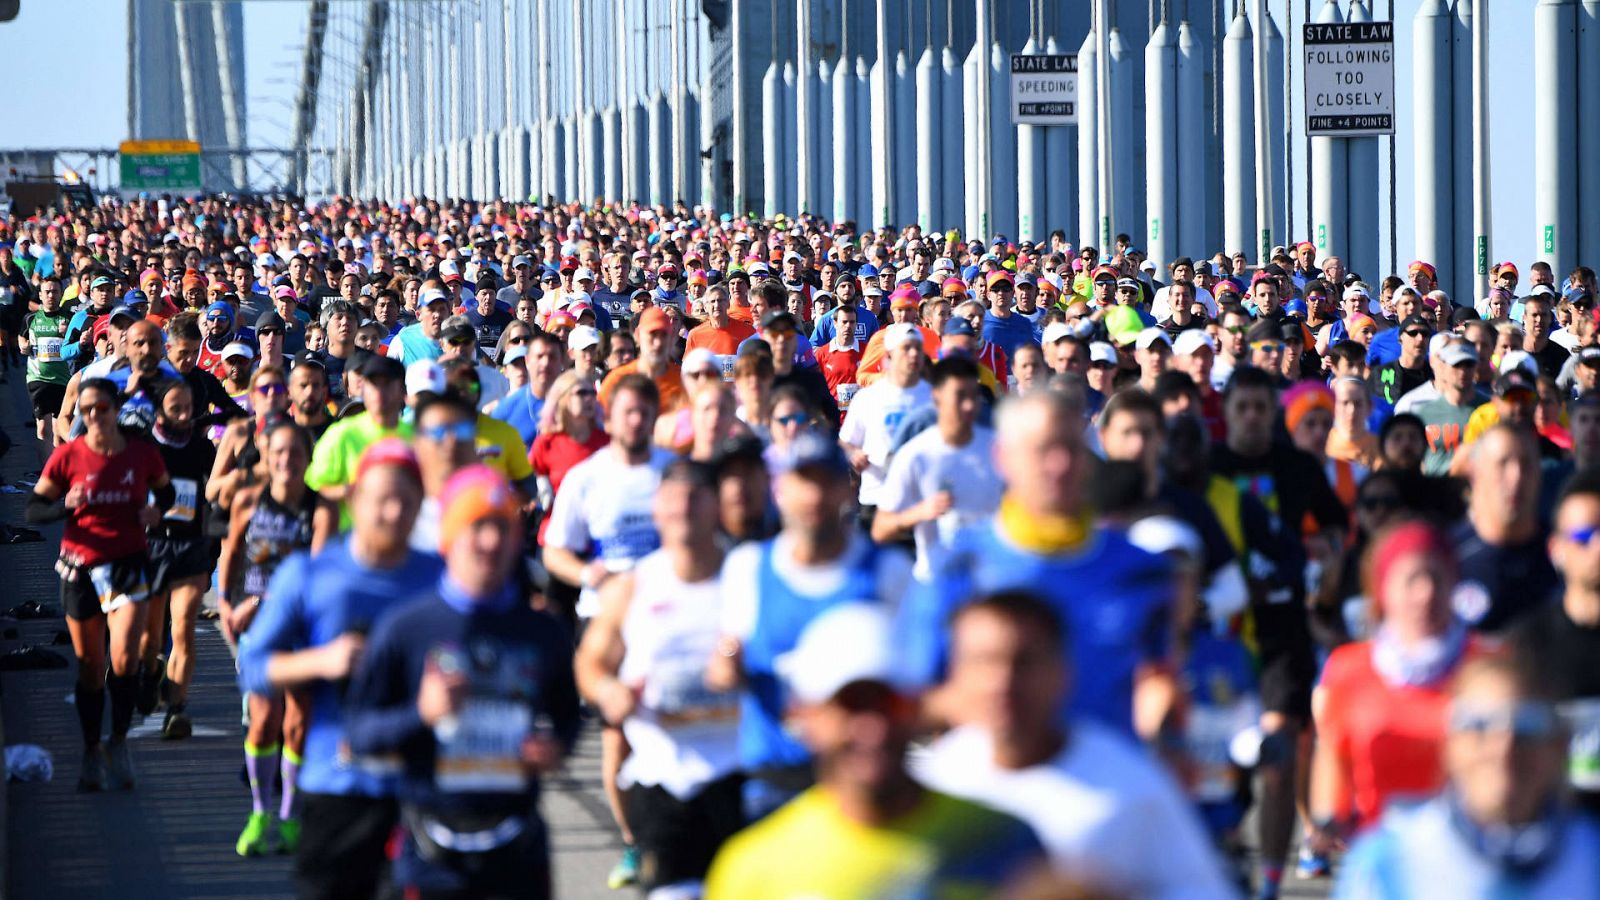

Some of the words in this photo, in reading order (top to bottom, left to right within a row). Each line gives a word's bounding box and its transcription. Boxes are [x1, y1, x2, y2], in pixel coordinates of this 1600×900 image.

[1306, 26, 1352, 40] STATE
[1360, 25, 1391, 39] LAW
[1013, 57, 1048, 70] STATE
[1054, 57, 1078, 70] LAW
[1308, 50, 1390, 64] FOLLOWING
[1336, 72, 1364, 85] TOO
[1018, 80, 1074, 93] SPEEDING
[1316, 92, 1382, 106] CLOSELY
[1021, 104, 1037, 114] FINE
[1312, 118, 1333, 128] FINE
[1355, 116, 1389, 127] POINTS
[1545, 230, 1552, 249] 78
